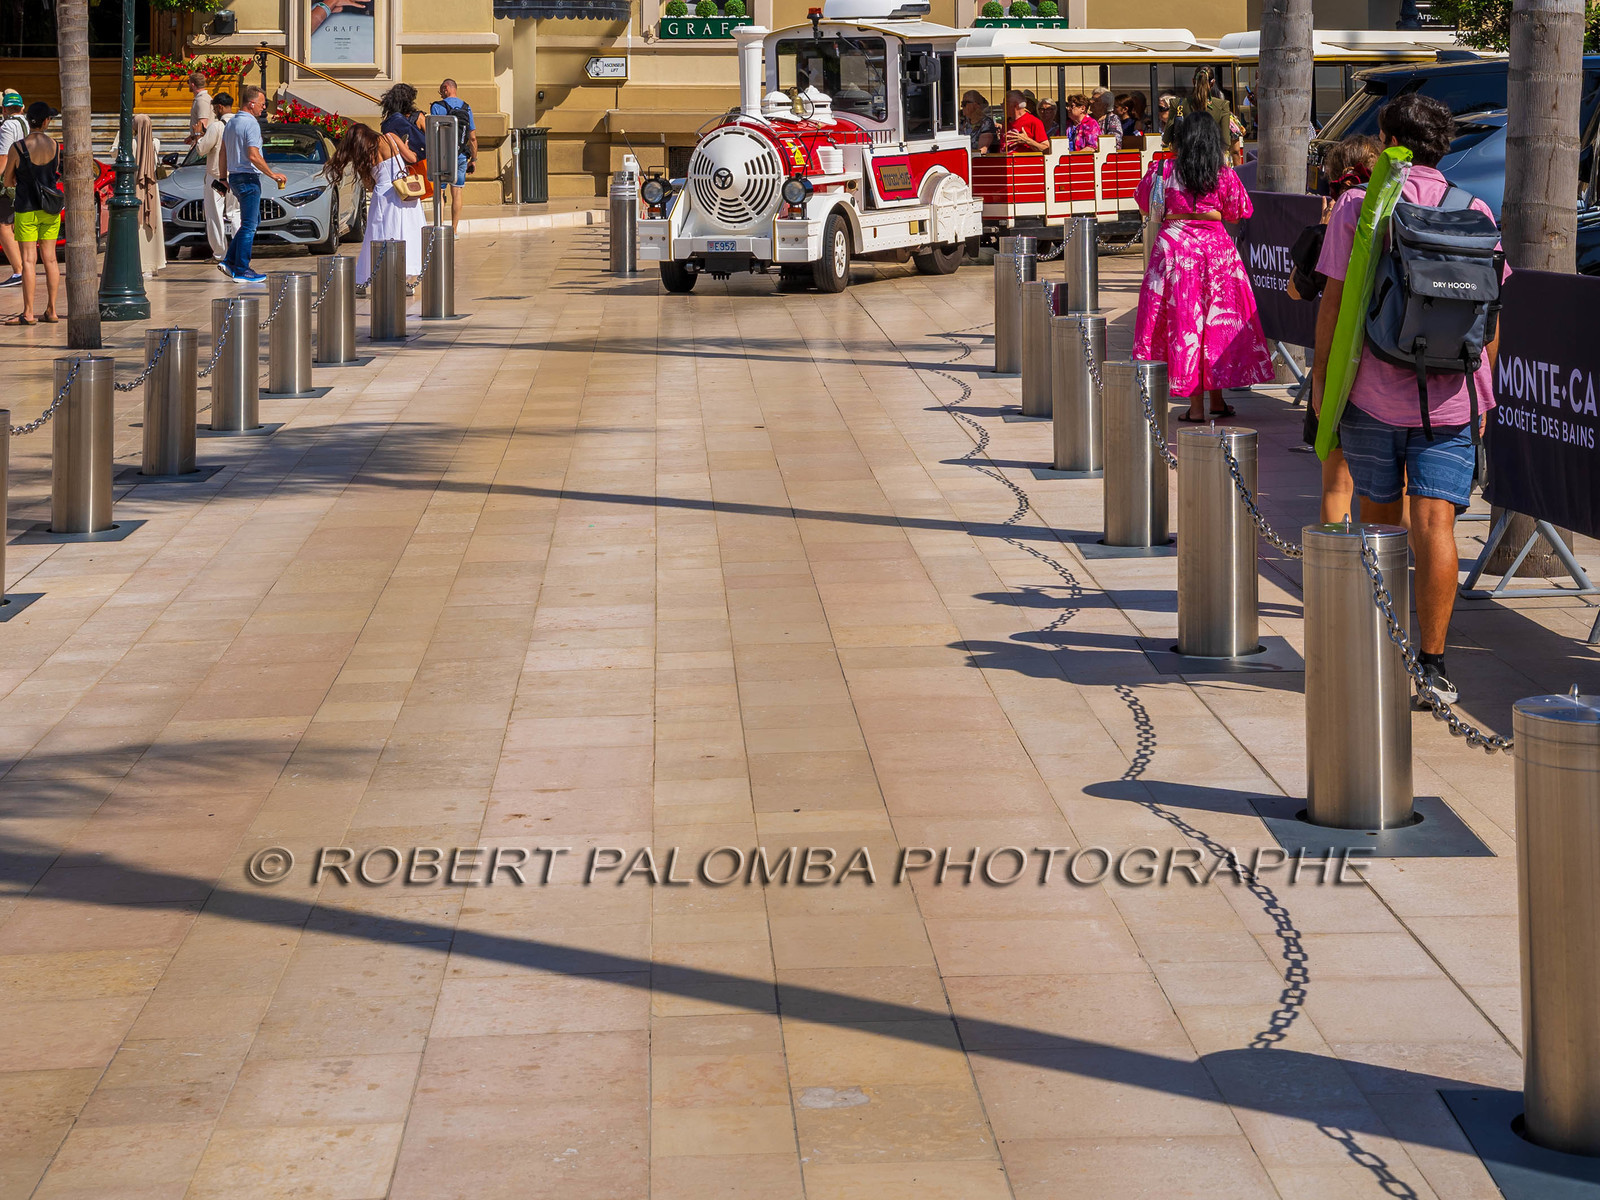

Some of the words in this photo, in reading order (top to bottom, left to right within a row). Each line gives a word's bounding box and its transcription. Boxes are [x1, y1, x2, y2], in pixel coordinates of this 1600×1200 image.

[714, 242, 736, 251] E952
[1253, 274, 1277, 290] SOCIÉTÉ
[1498, 404, 1537, 434] SOCIÉTÉ
[1541, 415, 1559, 440] DES
[1562, 421, 1595, 449] BAINS
